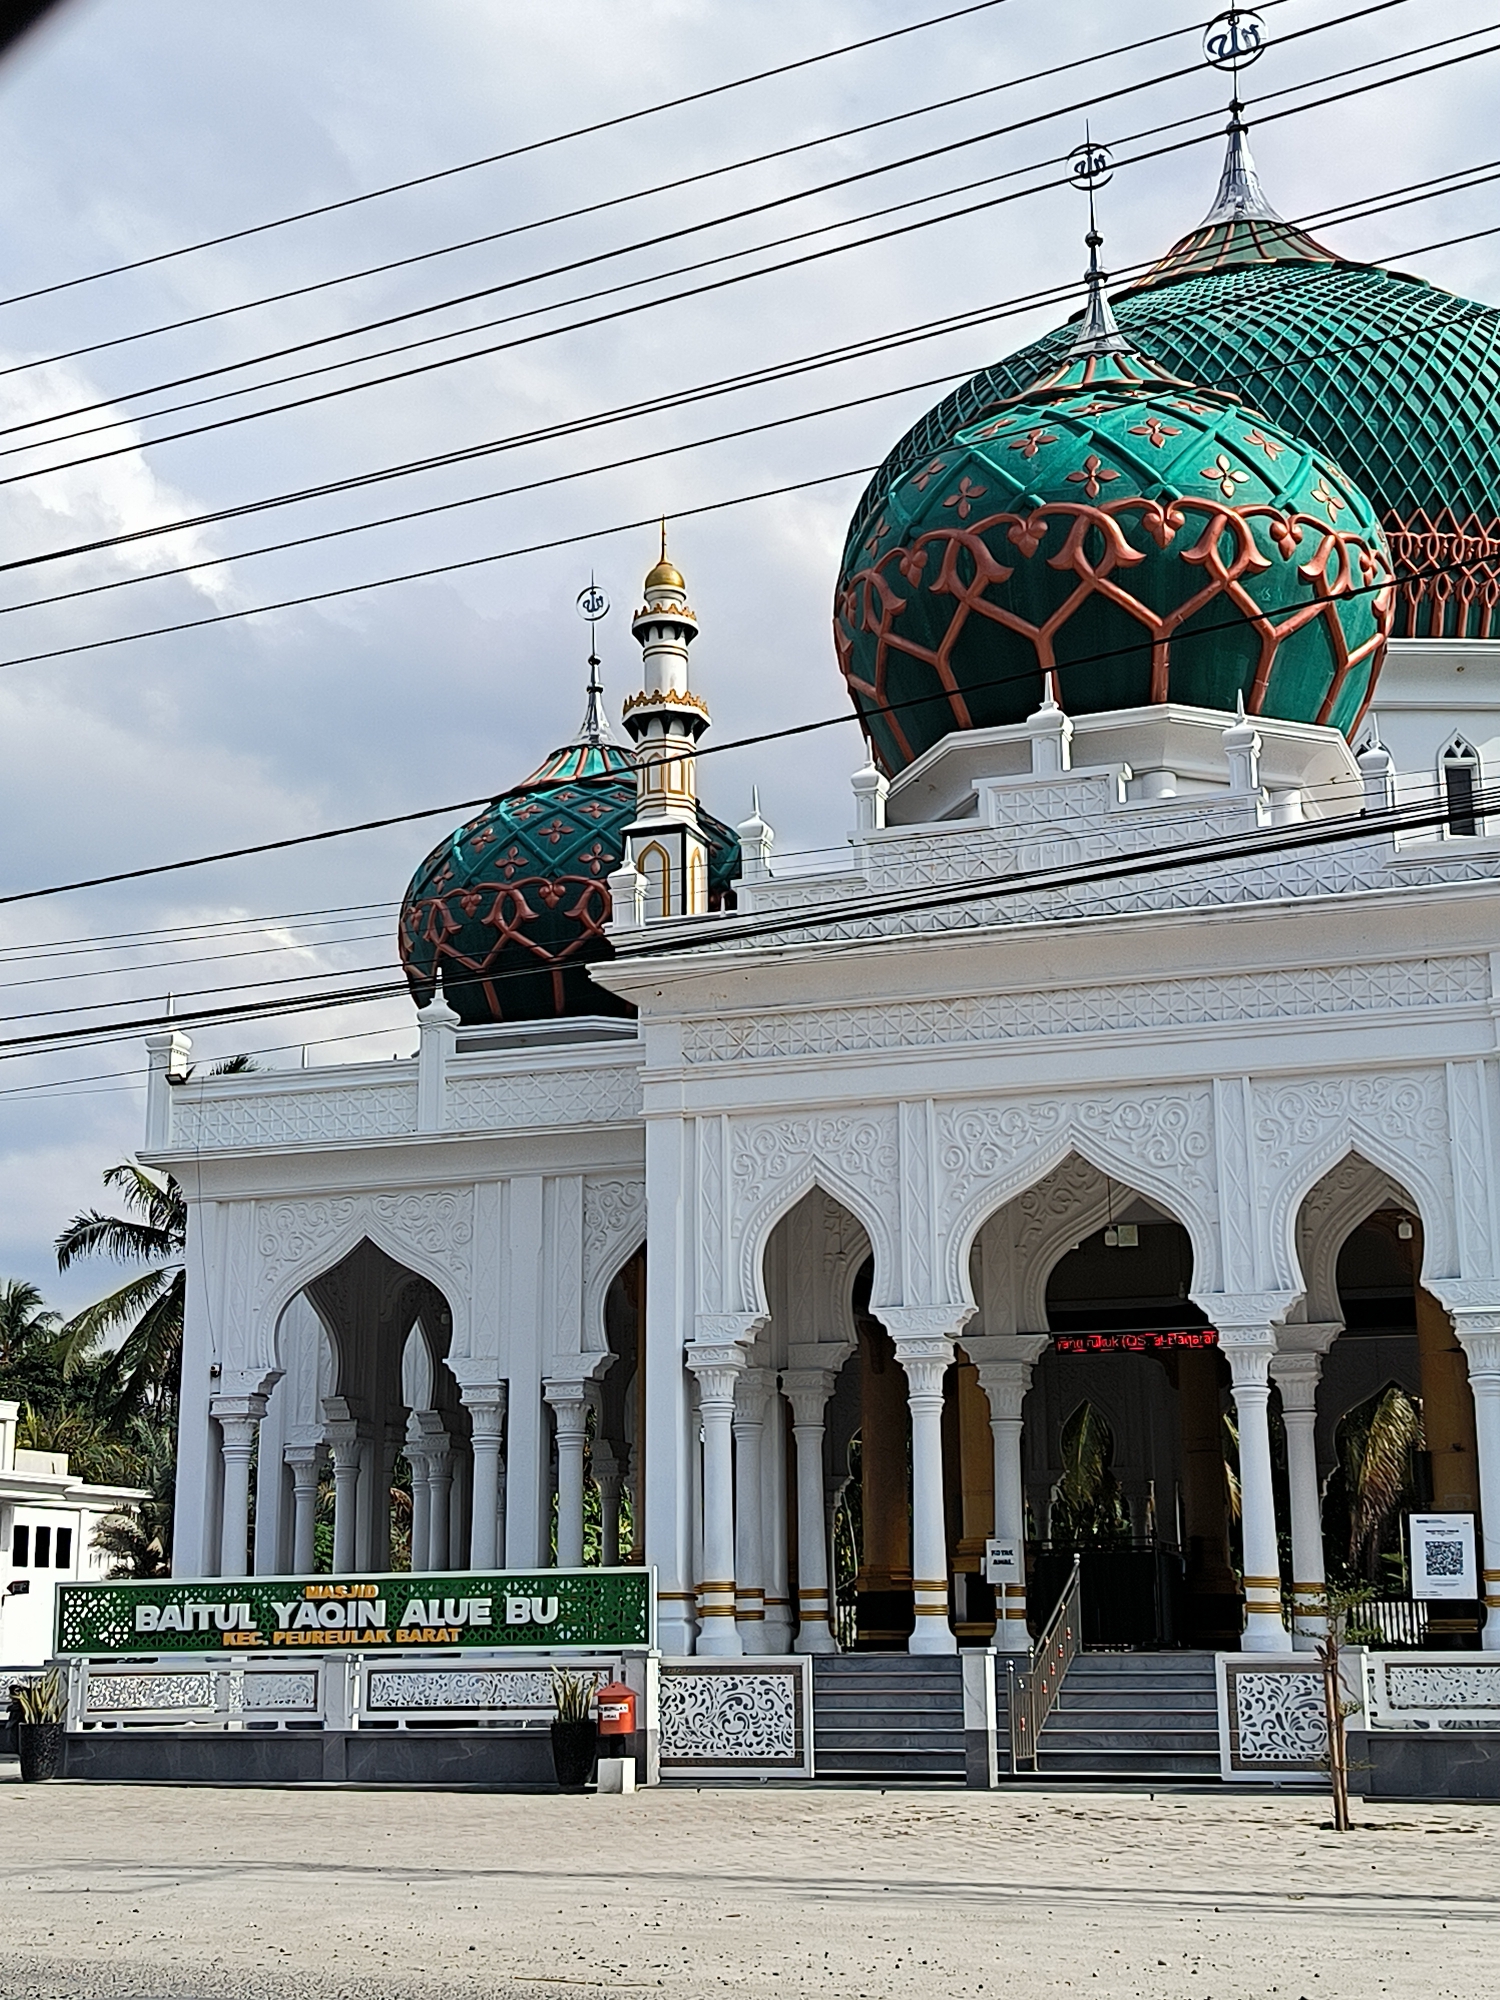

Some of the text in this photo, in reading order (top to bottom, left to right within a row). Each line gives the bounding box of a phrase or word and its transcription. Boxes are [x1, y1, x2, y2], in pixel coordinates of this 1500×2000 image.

[305, 1583, 379, 1600] MASJID
[134, 1595, 560, 1632] BAITUL YAQIN ALUE BU
[222, 1627, 463, 1647] KEC. PEUREULAK BARAT
